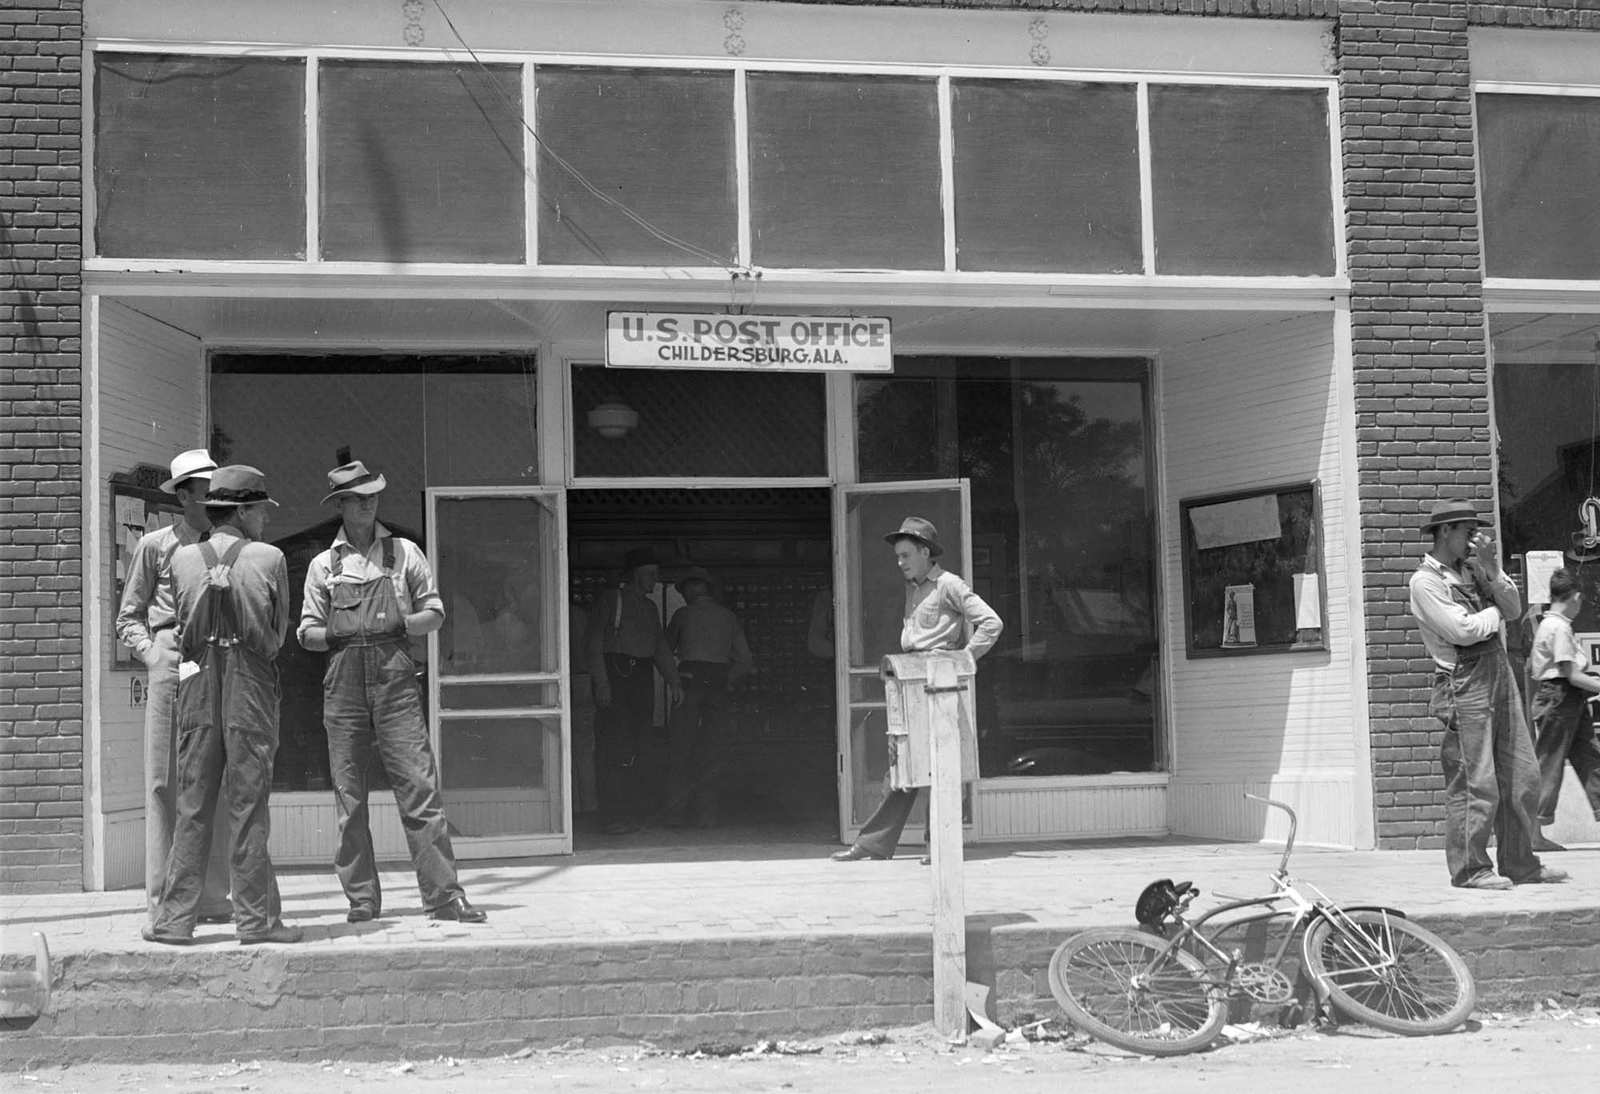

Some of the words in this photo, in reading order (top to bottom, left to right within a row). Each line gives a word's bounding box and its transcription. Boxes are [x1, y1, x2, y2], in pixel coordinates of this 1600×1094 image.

[623, 317, 687, 343] U.S.
[693, 319, 781, 345] POST
[791, 321, 884, 347] OFFICE
